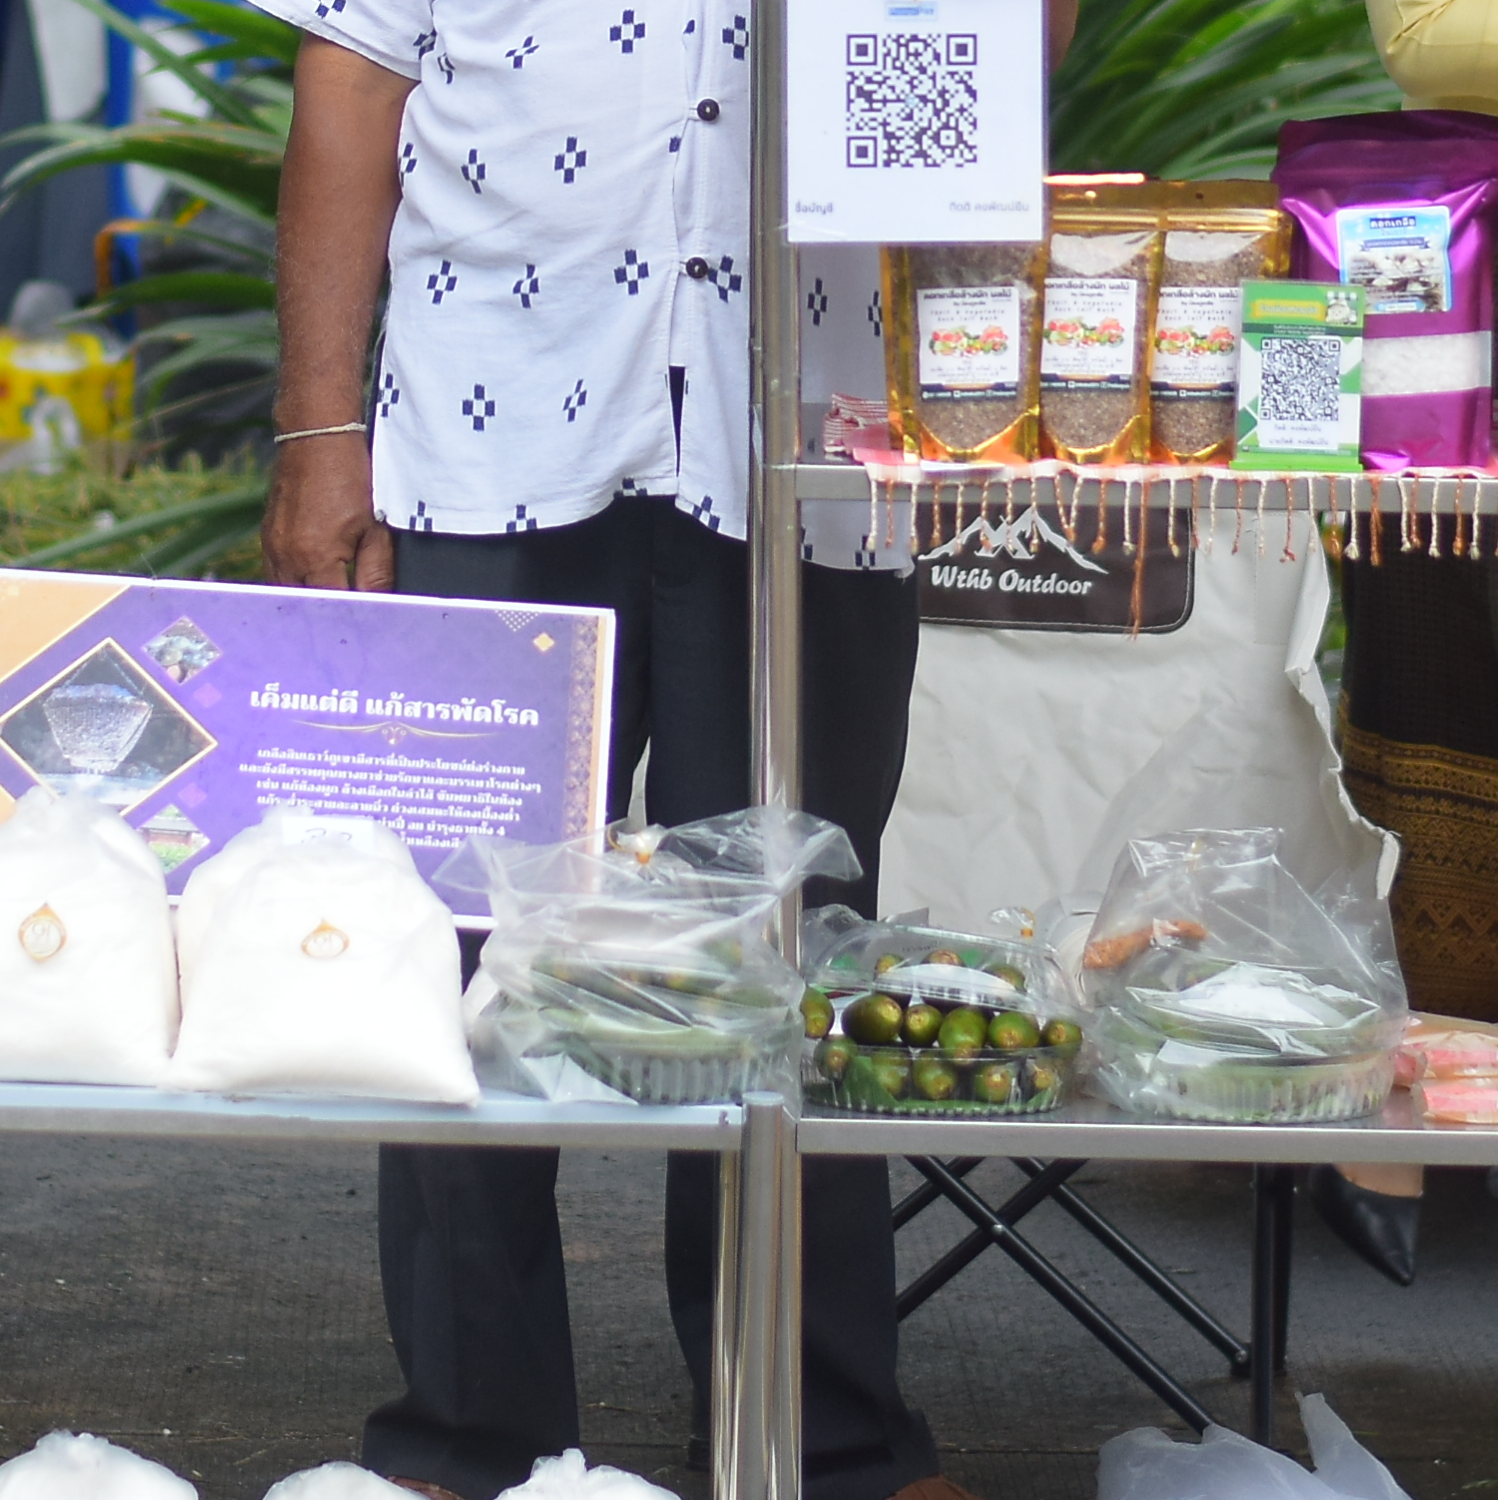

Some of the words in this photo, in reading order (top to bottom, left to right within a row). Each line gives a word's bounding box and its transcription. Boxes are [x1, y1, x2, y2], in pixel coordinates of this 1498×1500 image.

[931, 564, 993, 590] Wthb
[998, 568, 1092, 595] Outdoor
[250, 681, 360, 715] เค็มแต่ดี
[365, 690, 540, 726] แก้สารพัดโรค
